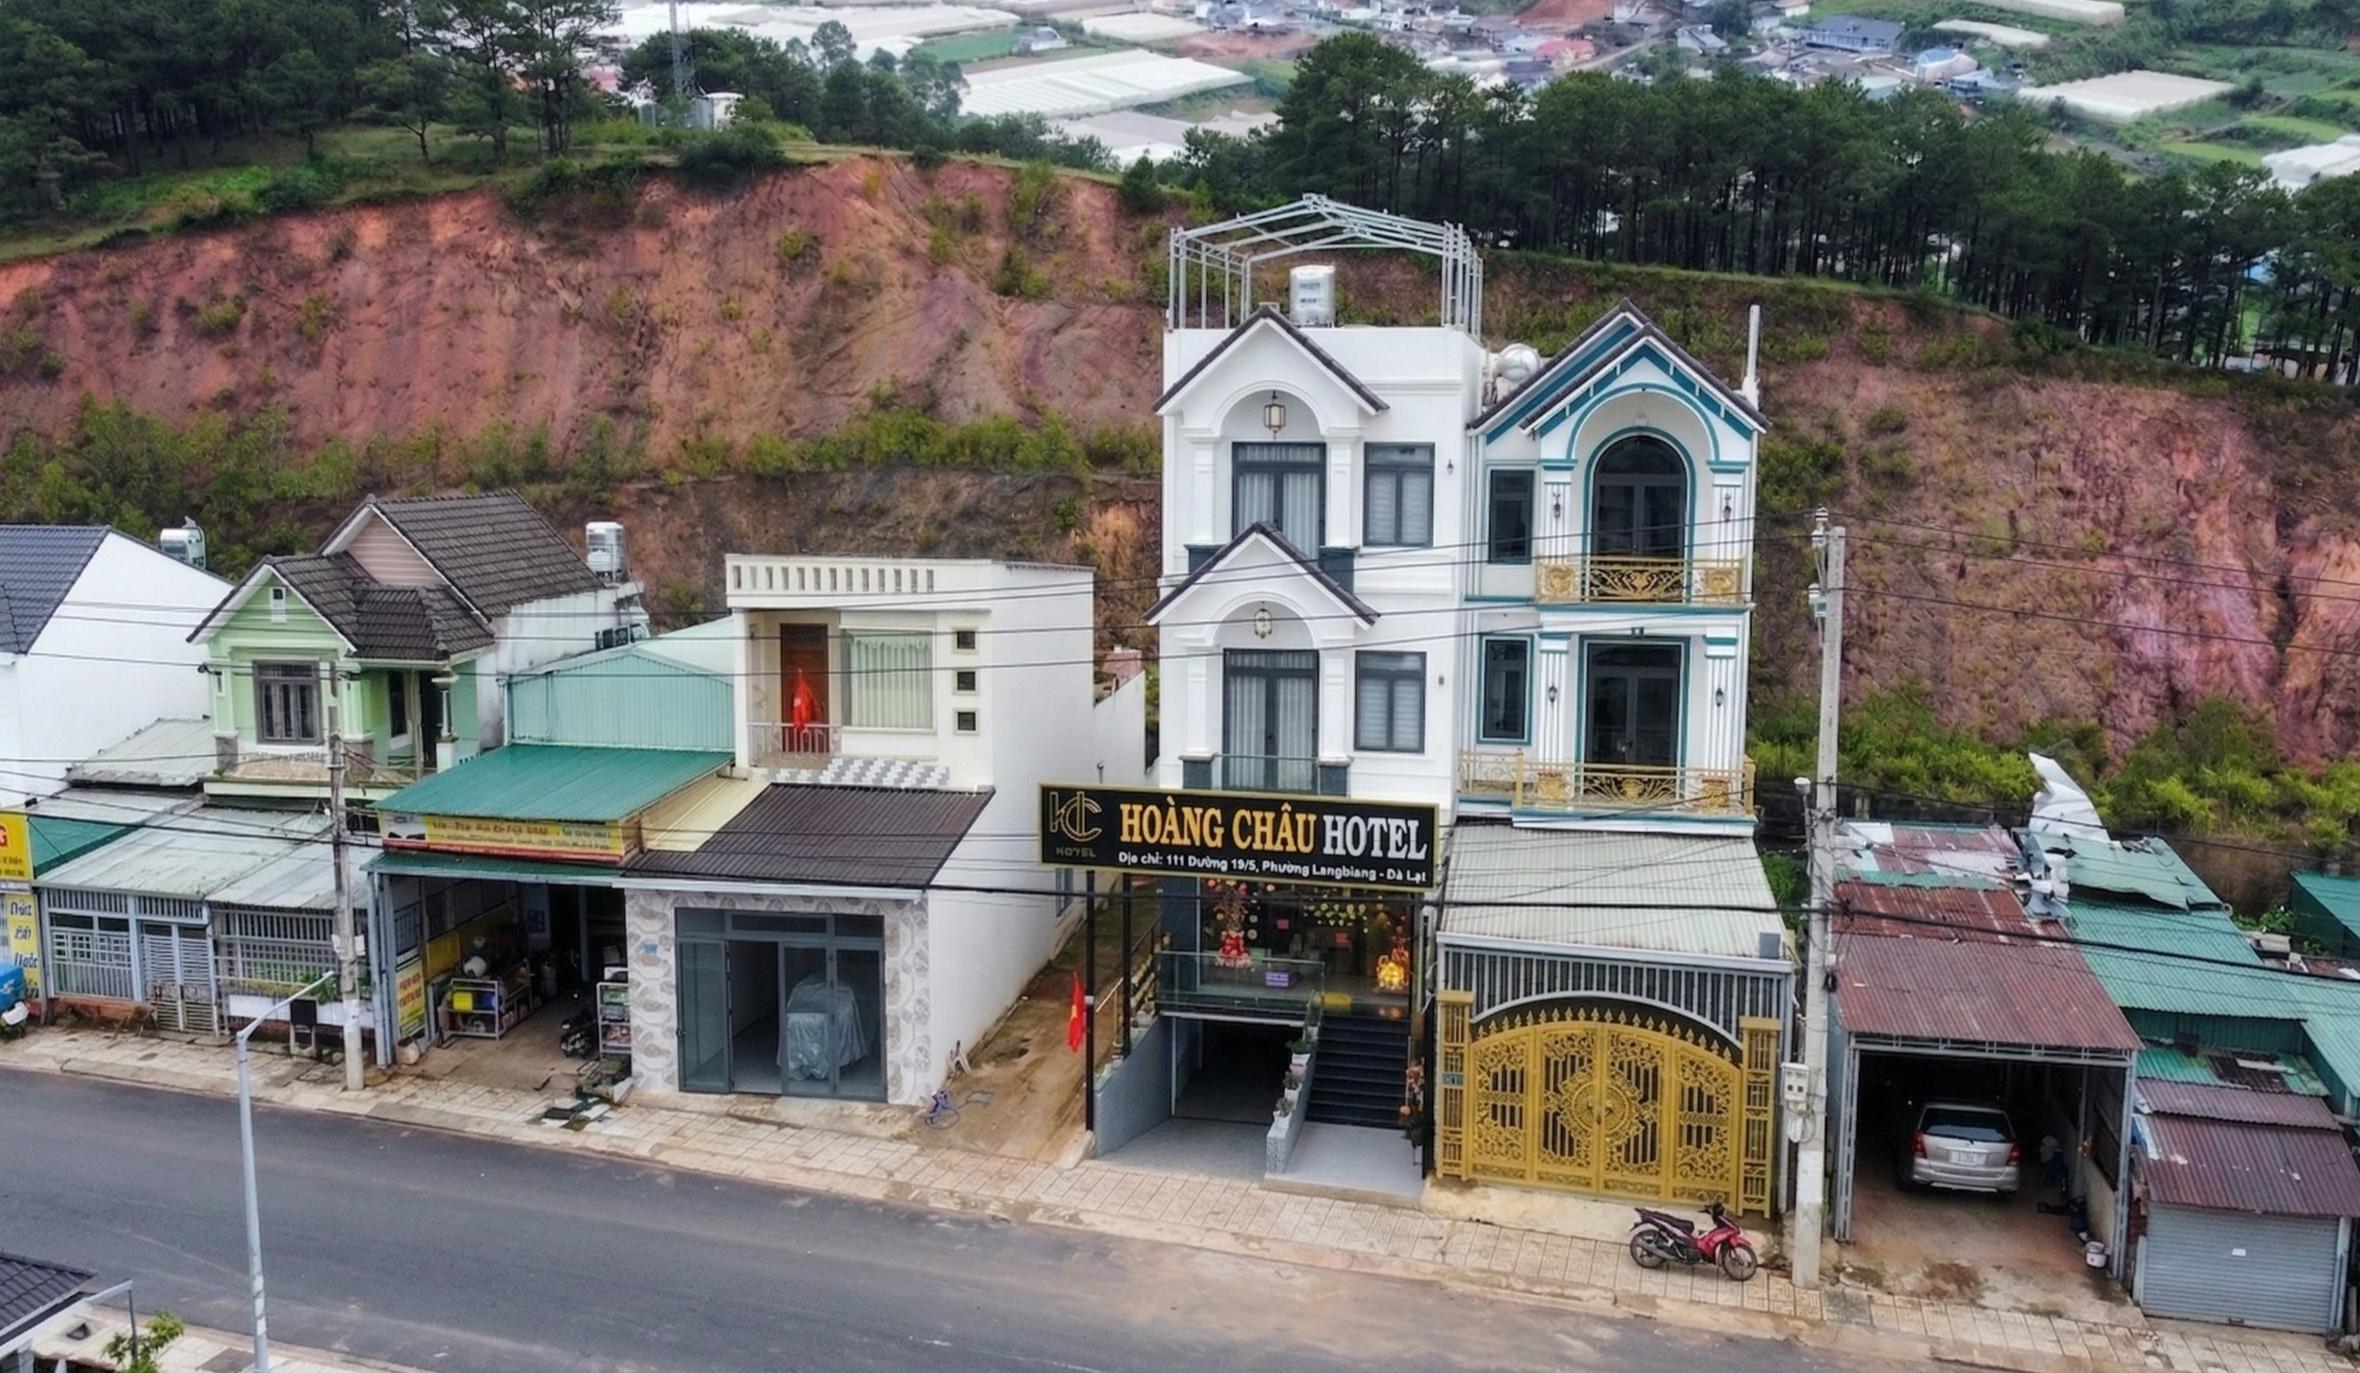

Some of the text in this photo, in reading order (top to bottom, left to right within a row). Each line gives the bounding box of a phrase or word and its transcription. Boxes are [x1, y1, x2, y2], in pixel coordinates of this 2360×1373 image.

[1119, 796, 1428, 860] HOÀNG CHÂU HOTEL
[1056, 847, 1096, 858] HOTEL
[1167, 854, 1185, 867] 111
[1231, 858, 1260, 873] 19/5,
[1262, 860, 1310, 877] Phường
[1312, 864, 1377, 881] Langbiang
